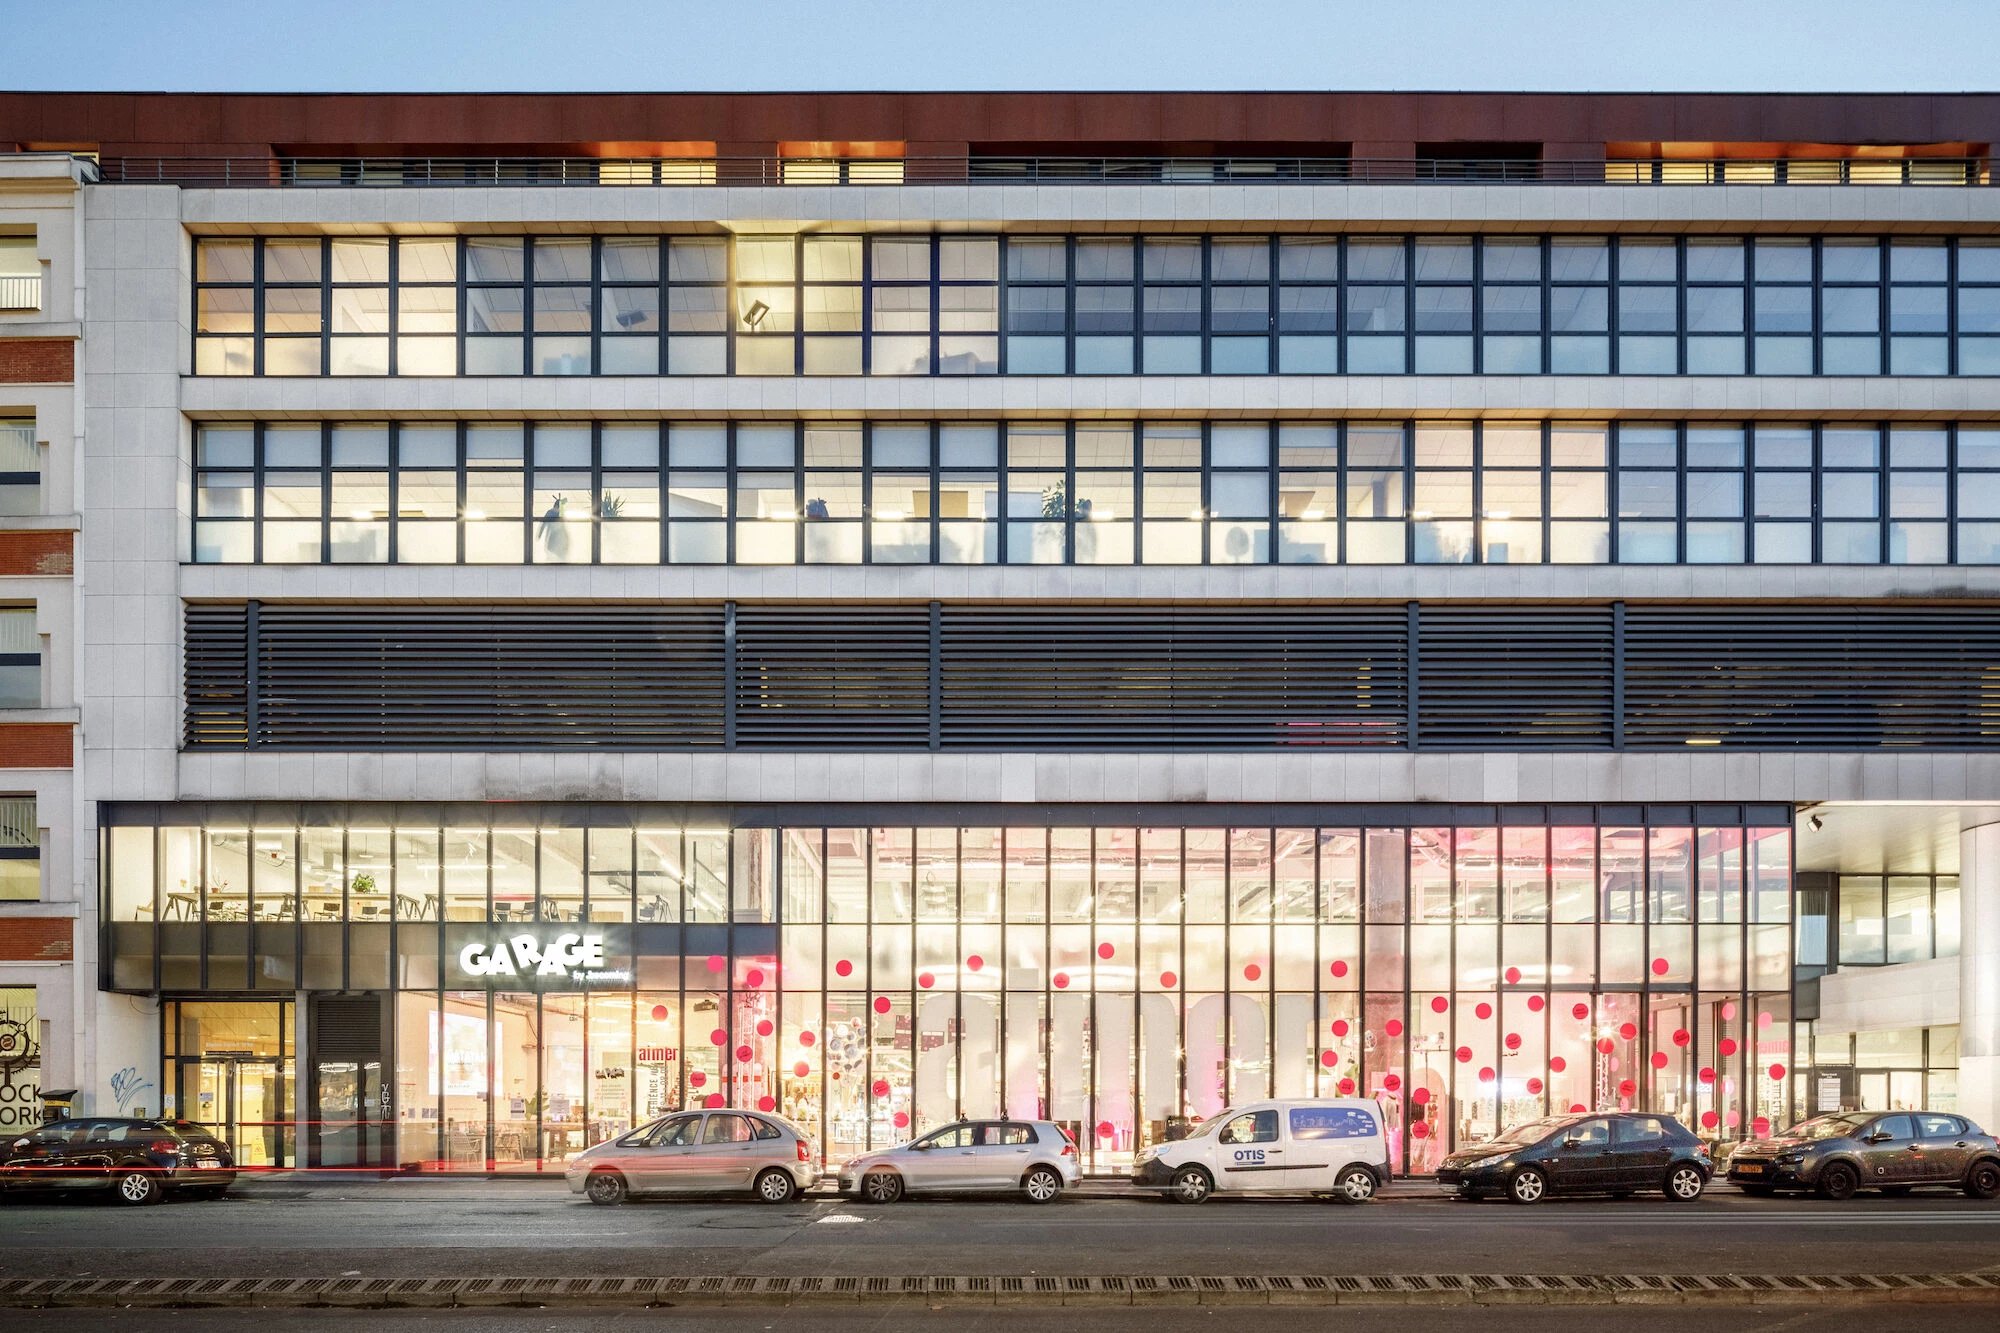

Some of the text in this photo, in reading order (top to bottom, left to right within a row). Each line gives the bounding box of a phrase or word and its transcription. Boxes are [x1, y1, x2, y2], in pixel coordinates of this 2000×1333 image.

[459, 933, 605, 976] GARAGE
[573, 970, 585, 981] by
[638, 1045, 678, 1061] aimer
[0, 1084, 41, 1102] OCK
[0, 1106, 41, 1125] ORK
[1234, 1149, 1265, 1161] OTIS
